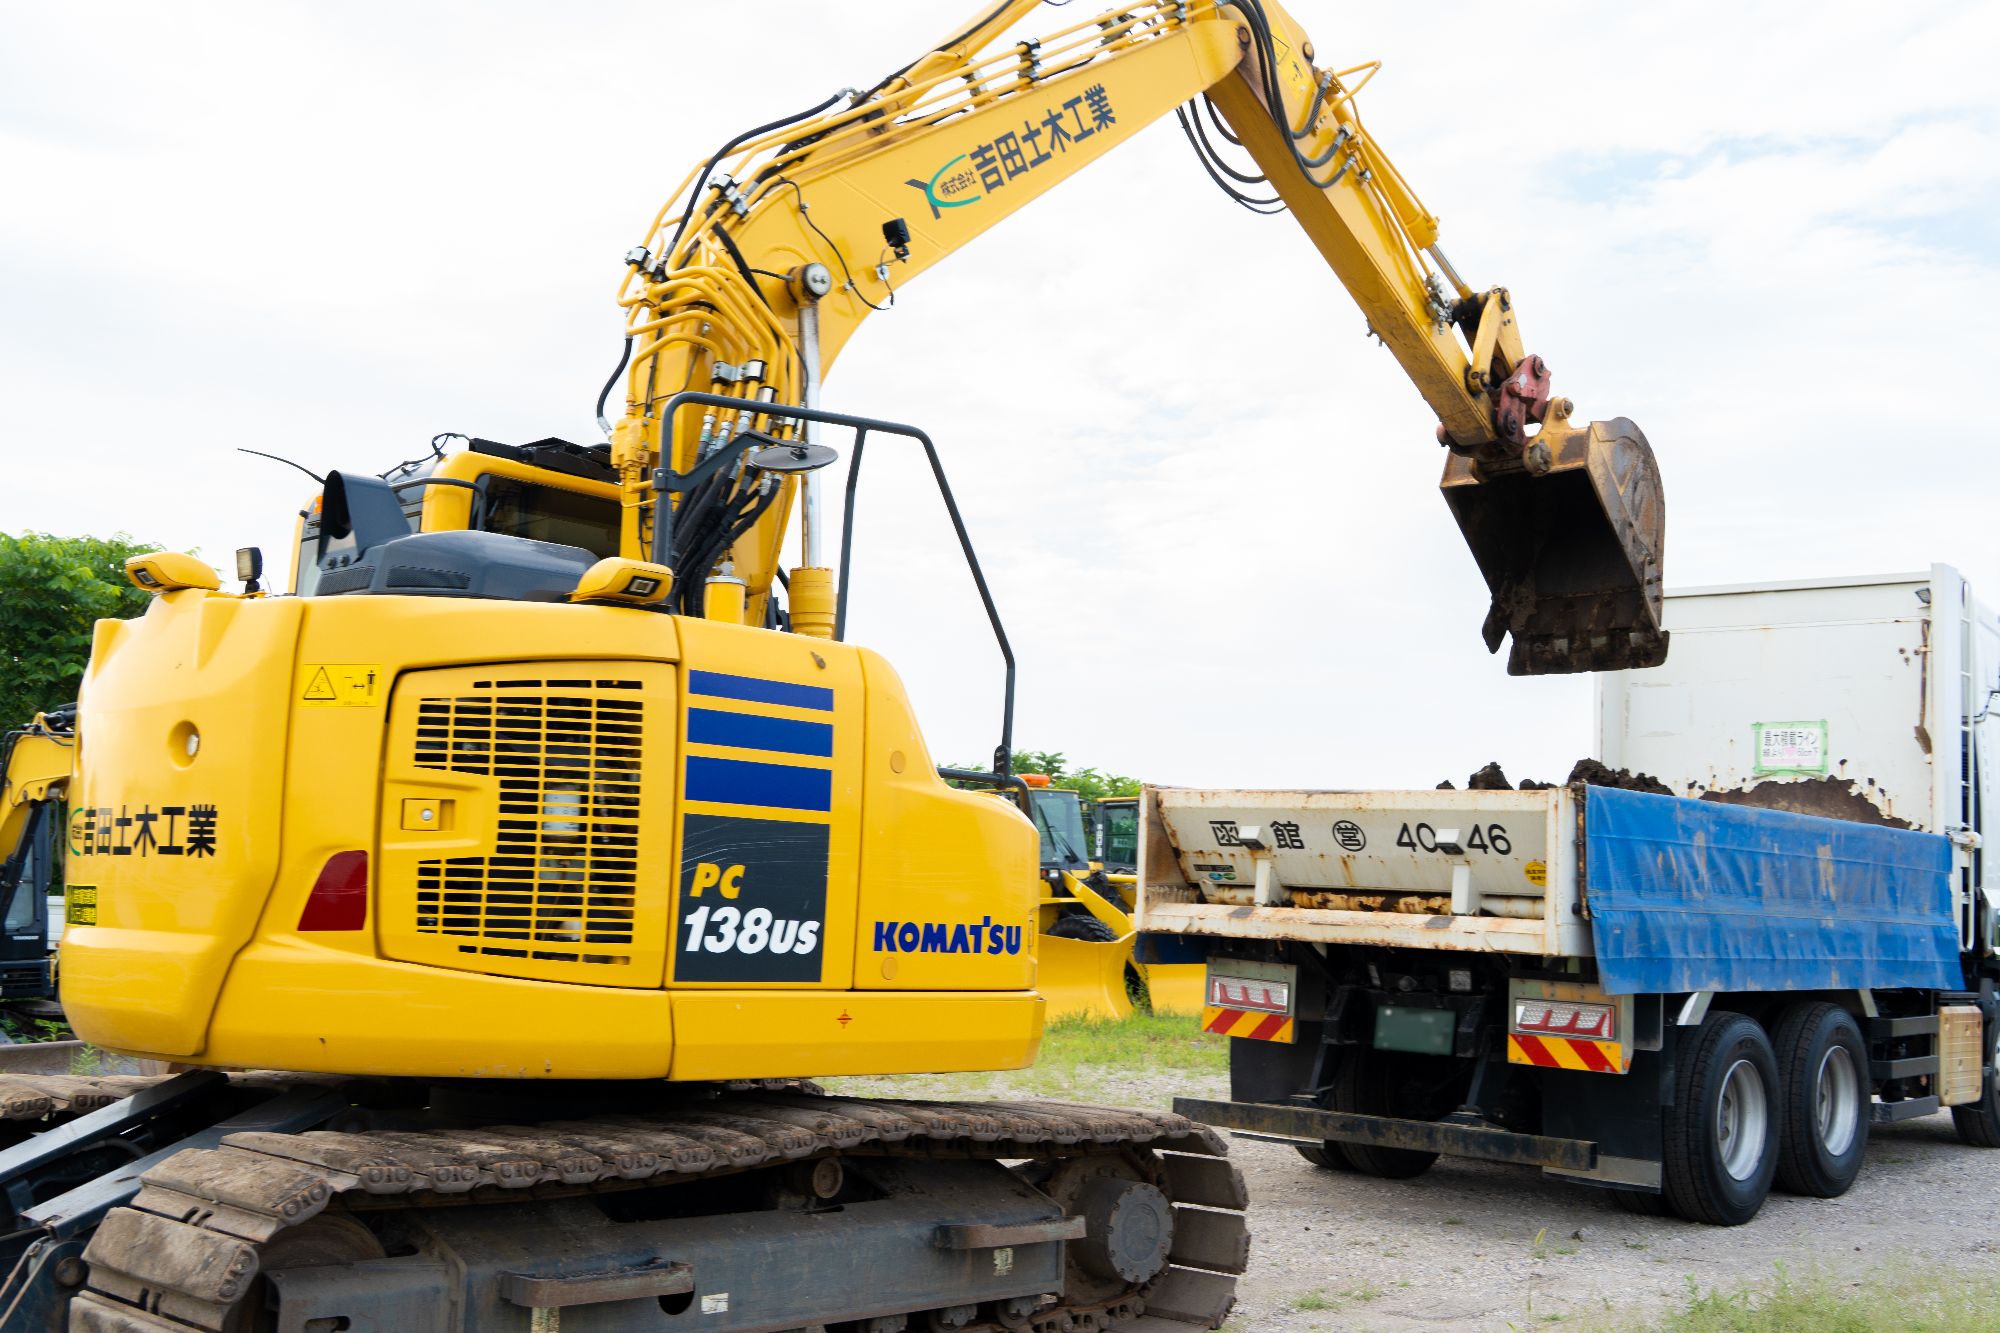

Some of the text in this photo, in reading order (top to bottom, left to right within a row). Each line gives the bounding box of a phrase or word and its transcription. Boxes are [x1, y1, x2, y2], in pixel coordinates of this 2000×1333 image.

[970, 83, 1116, 194] 吉田土木工業
[83, 804, 218, 858] 吉田土木工業
[689, 863, 745, 899] PC
[874, 915, 1022, 956] KOMATSU
